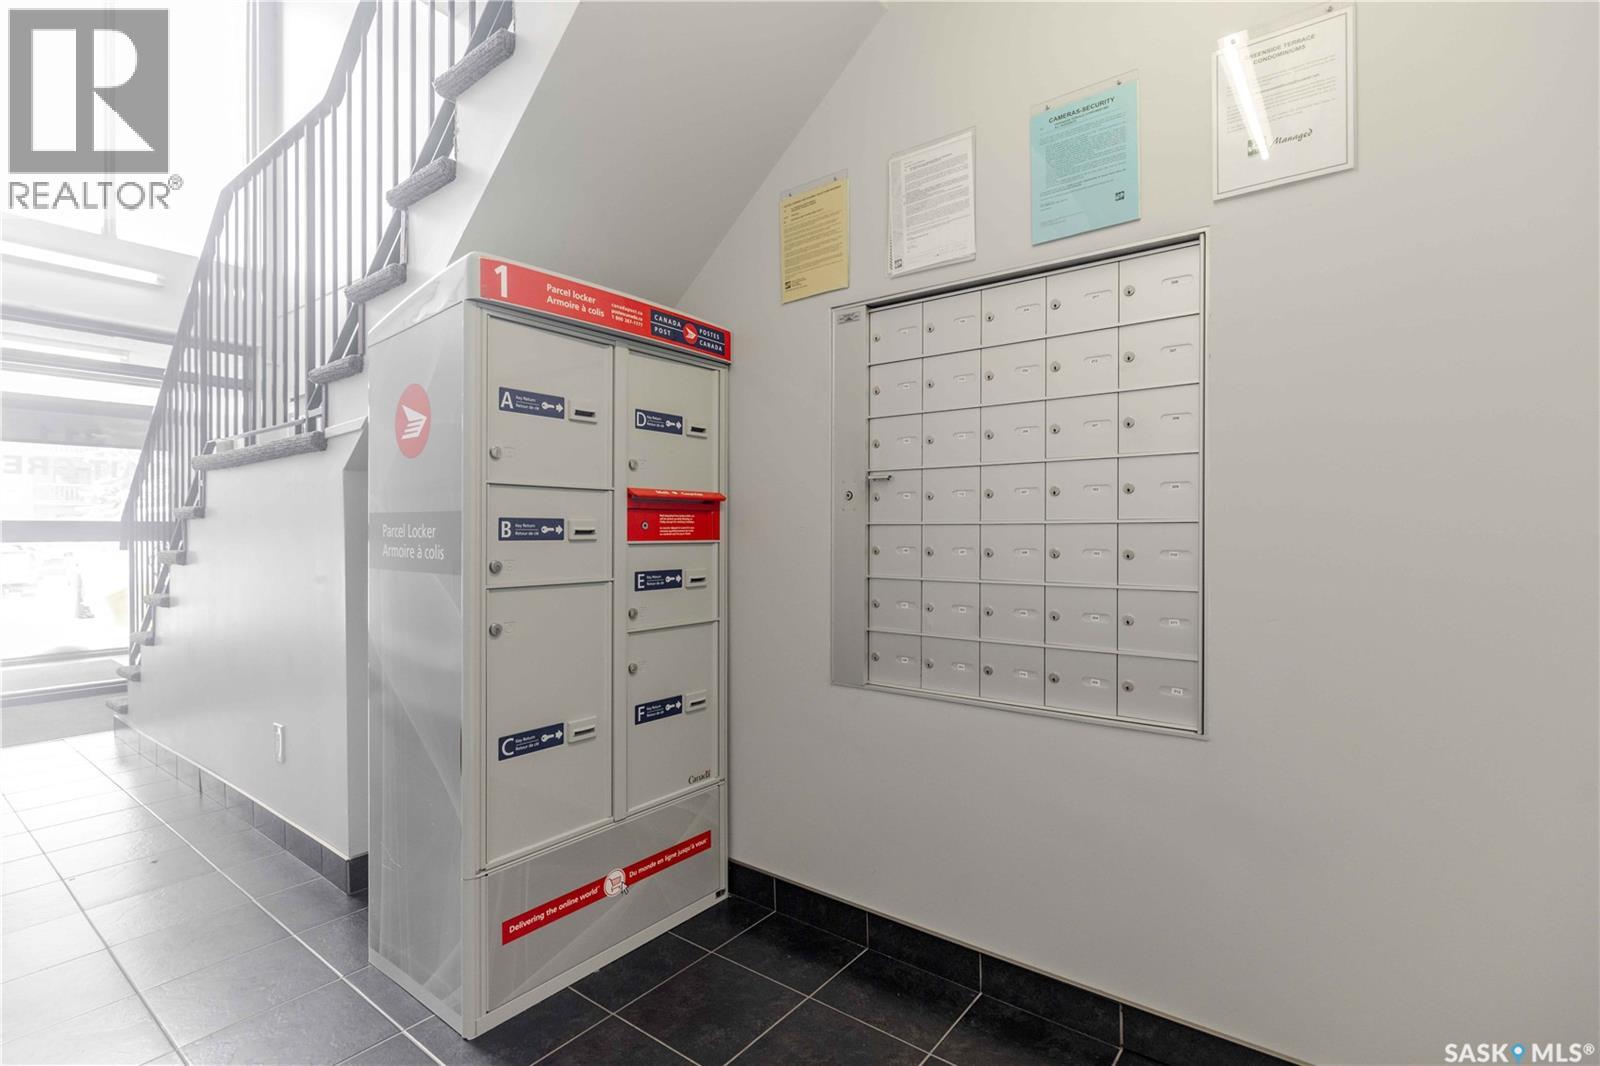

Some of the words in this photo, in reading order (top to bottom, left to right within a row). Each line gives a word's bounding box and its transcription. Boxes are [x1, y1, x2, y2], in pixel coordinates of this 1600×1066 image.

[1284, 34, 1315, 48] TERRACE
[1253, 44, 1306, 64] CONDOMINIUMS
[1048, 97, 1115, 123] CAMERAS-SECURITY
[1271, 128, 1313, 146] Managed
[494, 264, 508, 298] 1
[546, 284, 570, 298] Parcel
[572, 289, 596, 304] locker
[546, 295, 579, 311] Armoire
[581, 304, 587, 312] à
[587, 305, 605, 318] colis
[654, 315, 682, 328] CANADA
[654, 327, 671, 336] POST
[699, 328, 720, 340] POSTES
[699, 340, 723, 352] CANADA
[500, 392, 514, 409] A
[637, 412, 646, 426] D
[382, 523, 406, 538] Parcel
[408, 523, 436, 538] Locker
[501, 521, 511, 538] B
[382, 544, 415, 558] Armoire
[417, 544, 422, 559] à
[424, 544, 444, 560] colis
[638, 574, 645, 588] E
[638, 706, 645, 722] F
[502, 738, 514, 756] C
[688, 769, 711, 784] Canada
[628, 870, 637, 878] Du
[638, 861, 657, 874] monde
[657, 858, 664, 866] en
[664, 852, 677, 865] ligne
[677, 844, 695, 859] jusqu'à
[508, 909, 545, 934] Delivering
[546, 906, 557, 916] the
[558, 897, 579, 911] online
